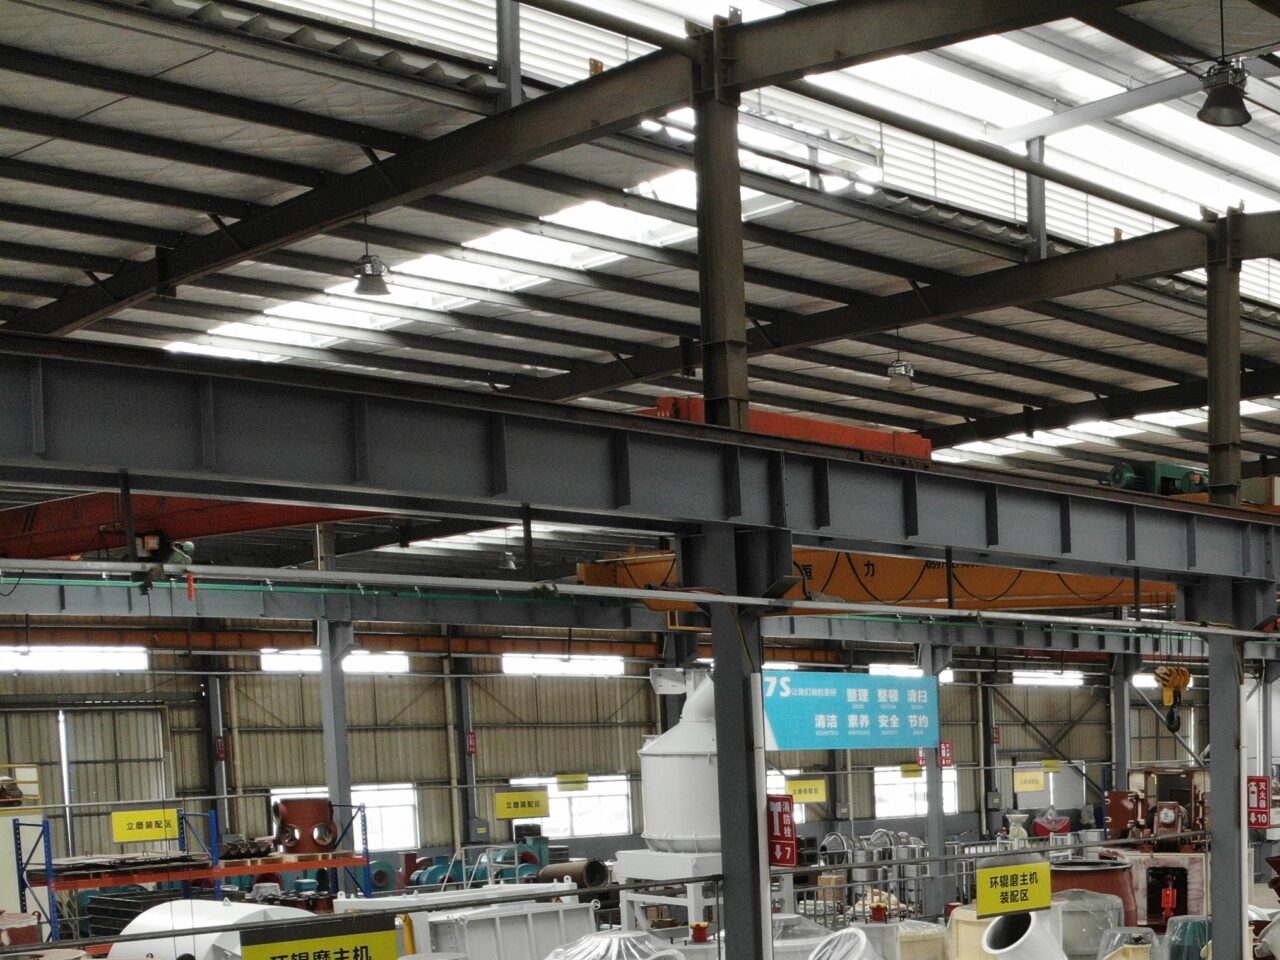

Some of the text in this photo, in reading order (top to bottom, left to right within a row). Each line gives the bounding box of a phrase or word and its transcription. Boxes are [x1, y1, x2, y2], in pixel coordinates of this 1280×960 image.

[764, 676, 791, 698] 7S
[907, 689, 928, 703] 清扫
[815, 714, 929, 728] 清洁 素养 安全 节约
[126, 819, 172, 831] 立磨装配区
[782, 801, 793, 837] 消防栓
[1257, 814, 1267, 824] 10
[784, 847, 791, 860] 7
[989, 871, 1039, 889] 环辊磨主机
[1000, 888, 1029, 904] 装配区
